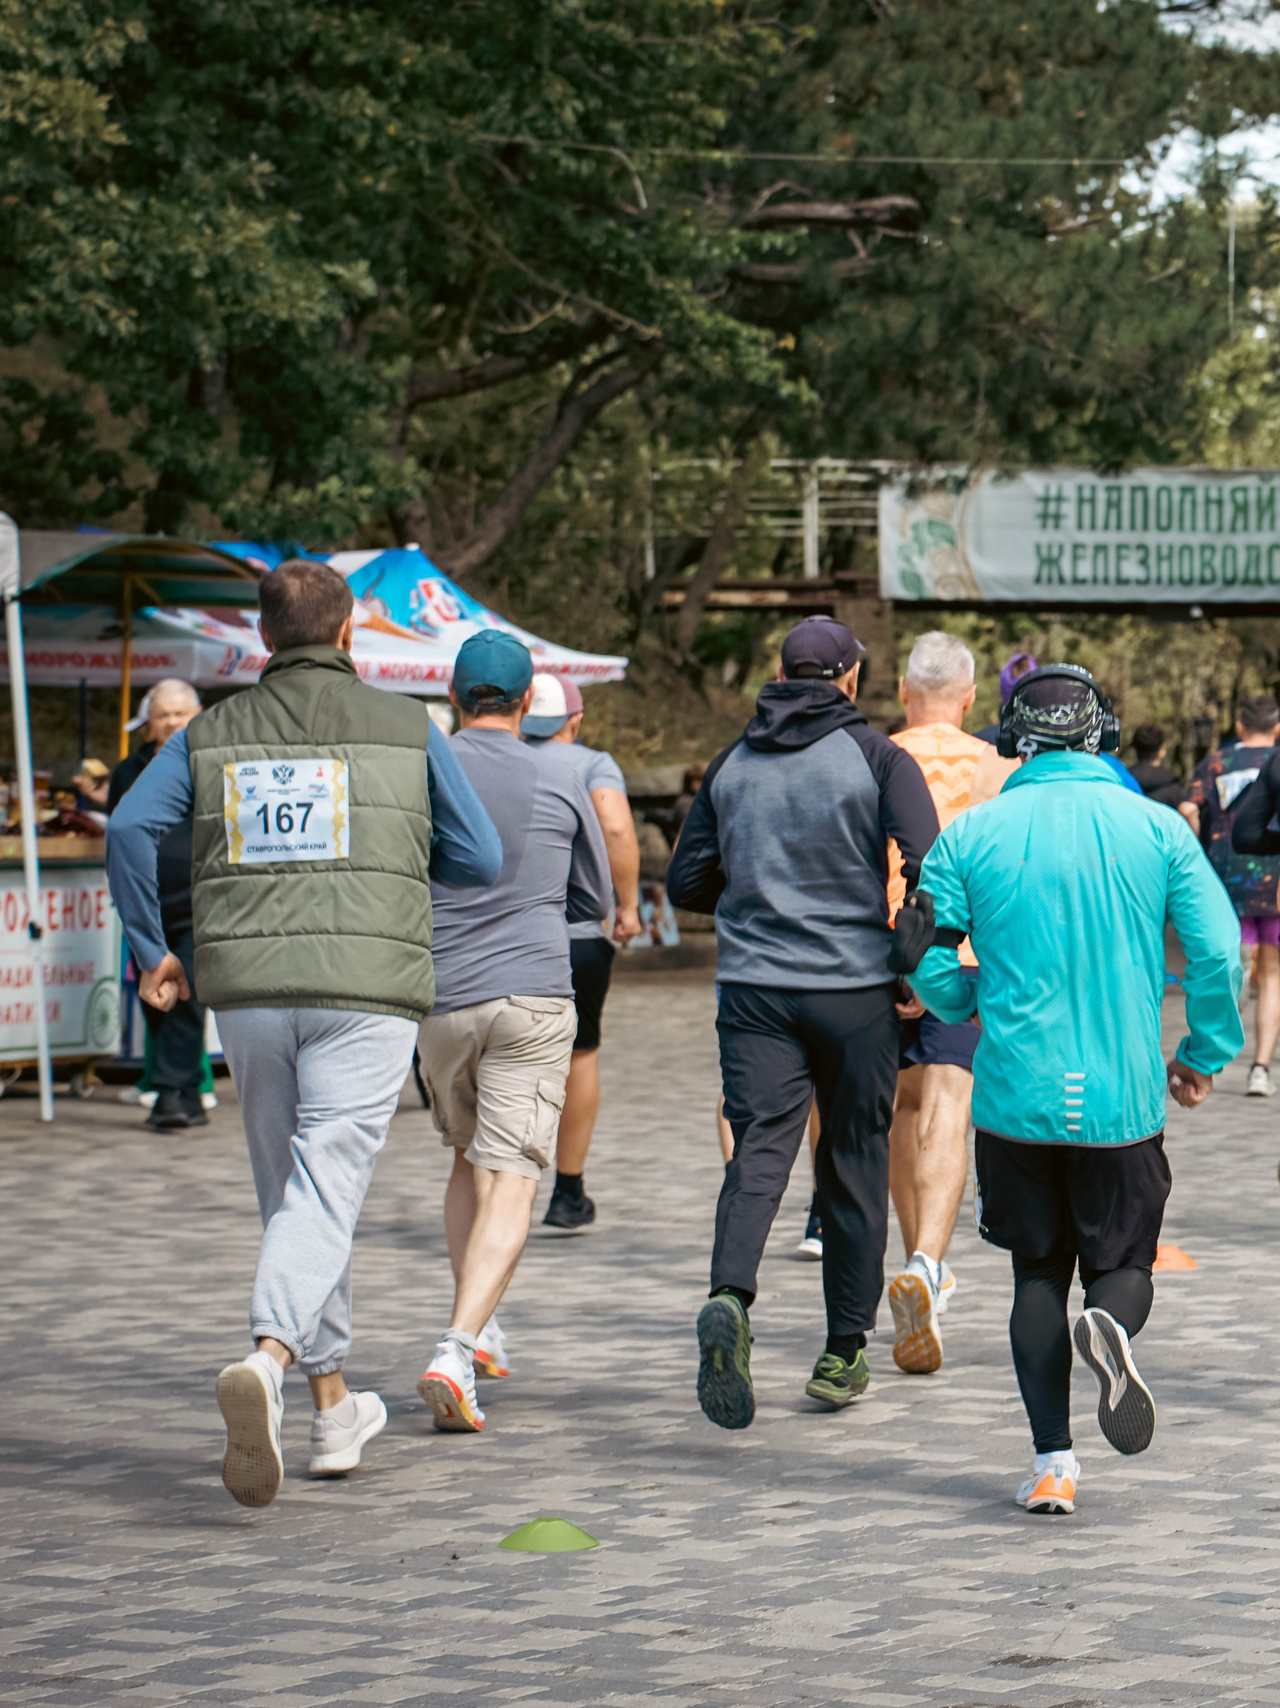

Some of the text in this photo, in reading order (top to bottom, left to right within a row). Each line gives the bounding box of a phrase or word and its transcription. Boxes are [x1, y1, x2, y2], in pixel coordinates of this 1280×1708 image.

[256, 802, 314, 835] 167
[246, 841, 328, 854] СТАВРОПОЛЬСКИЙ КРАЙ
